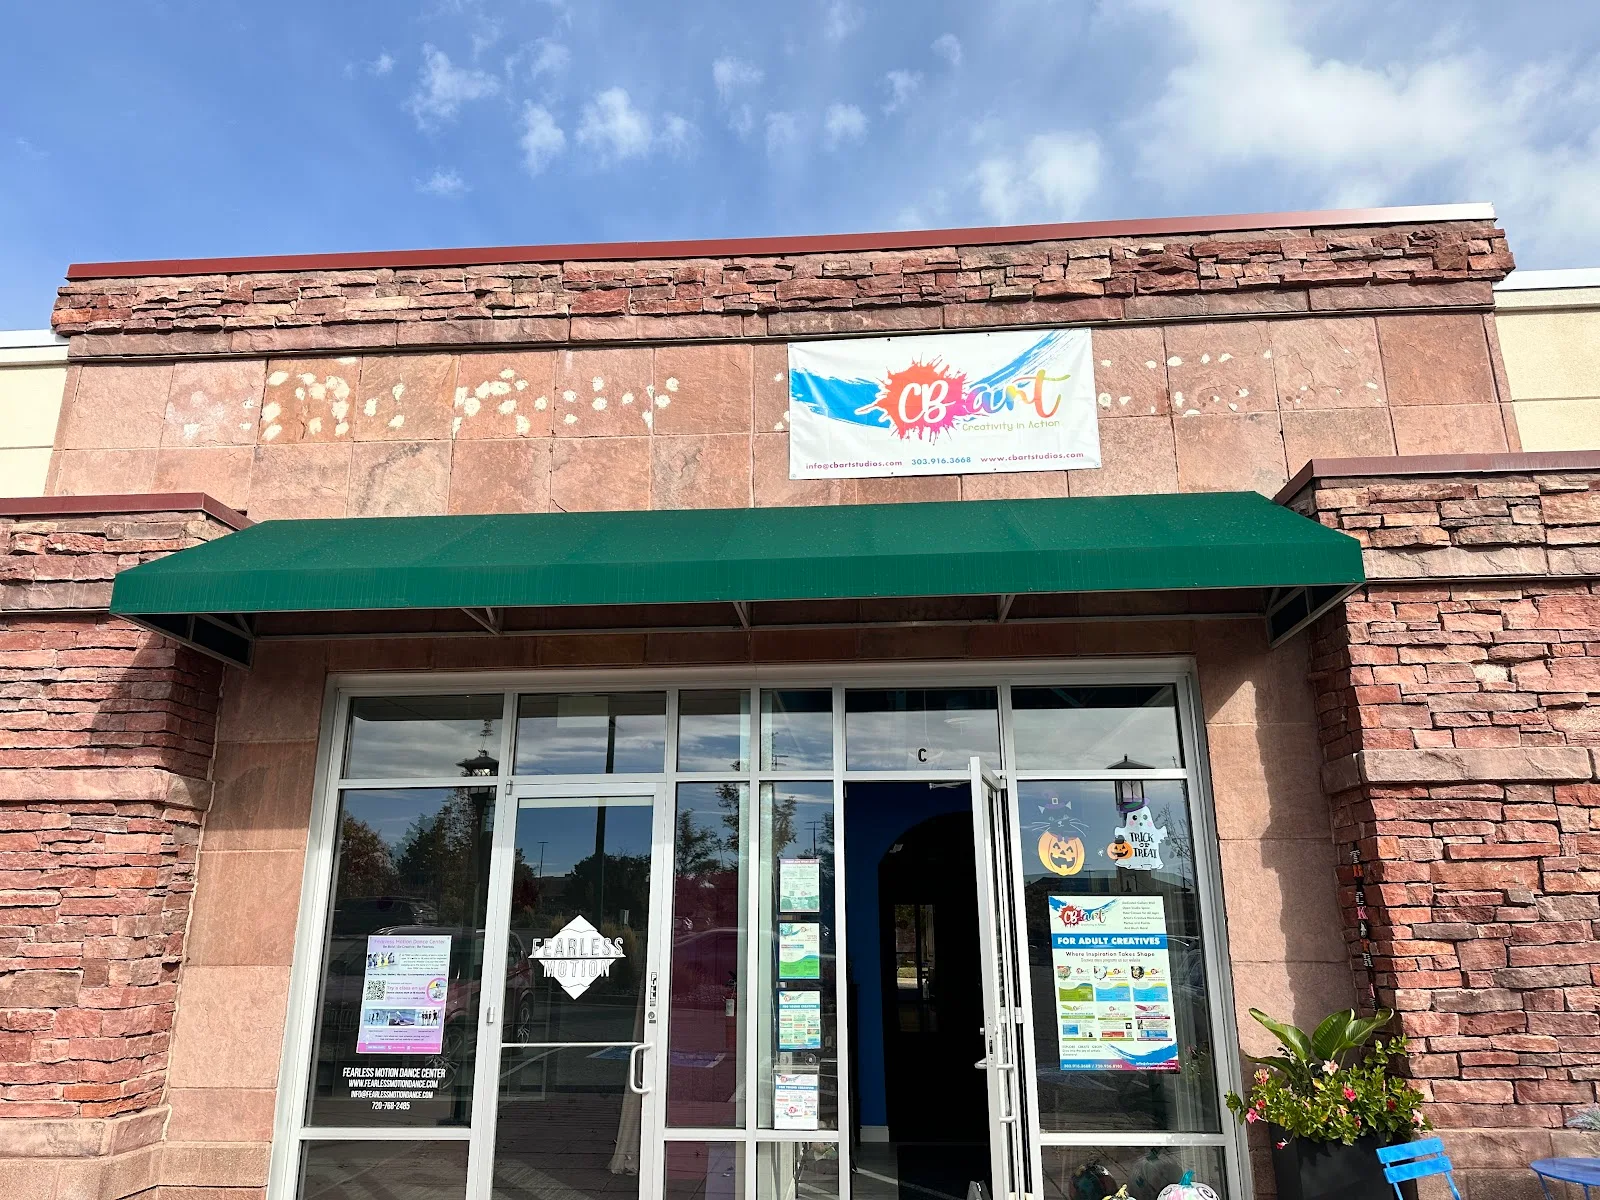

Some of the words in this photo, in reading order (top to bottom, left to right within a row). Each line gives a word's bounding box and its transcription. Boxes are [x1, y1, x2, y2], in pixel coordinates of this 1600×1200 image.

[963, 421, 1013, 432] Creativity
[1028, 420, 1060, 429] Action
[805, 459, 903, 470] info@cbartstudios.com
[911, 456, 972, 466] 303.916.3668
[980, 452, 1084, 462] www.cbartstudios.com
[917, 747, 927, 763] C
[1129, 832, 1154, 843] TRICK
[1133, 847, 1157, 858] TREAT
[1057, 937, 1076, 945] FOR
[1078, 937, 1108, 945] ADULT
[1111, 937, 1160, 945] CREATIVES
[531, 937, 624, 957] FEARLESS
[543, 960, 611, 978] MOTION
[342, 1067, 375, 1078] FEARLESS
[375, 1067, 400, 1078] MOTION
[400, 1068, 421, 1078] DANCE
[421, 1068, 446, 1078] CENTER
[348, 1079, 439, 1088] WWW.FEARLESSMOTIONDANCE.COM
[350, 1090, 434, 1099] INFO@FEARLESSMOTIONDANCE.COM
[371, 1101, 411, 1110] 720-768-2485
